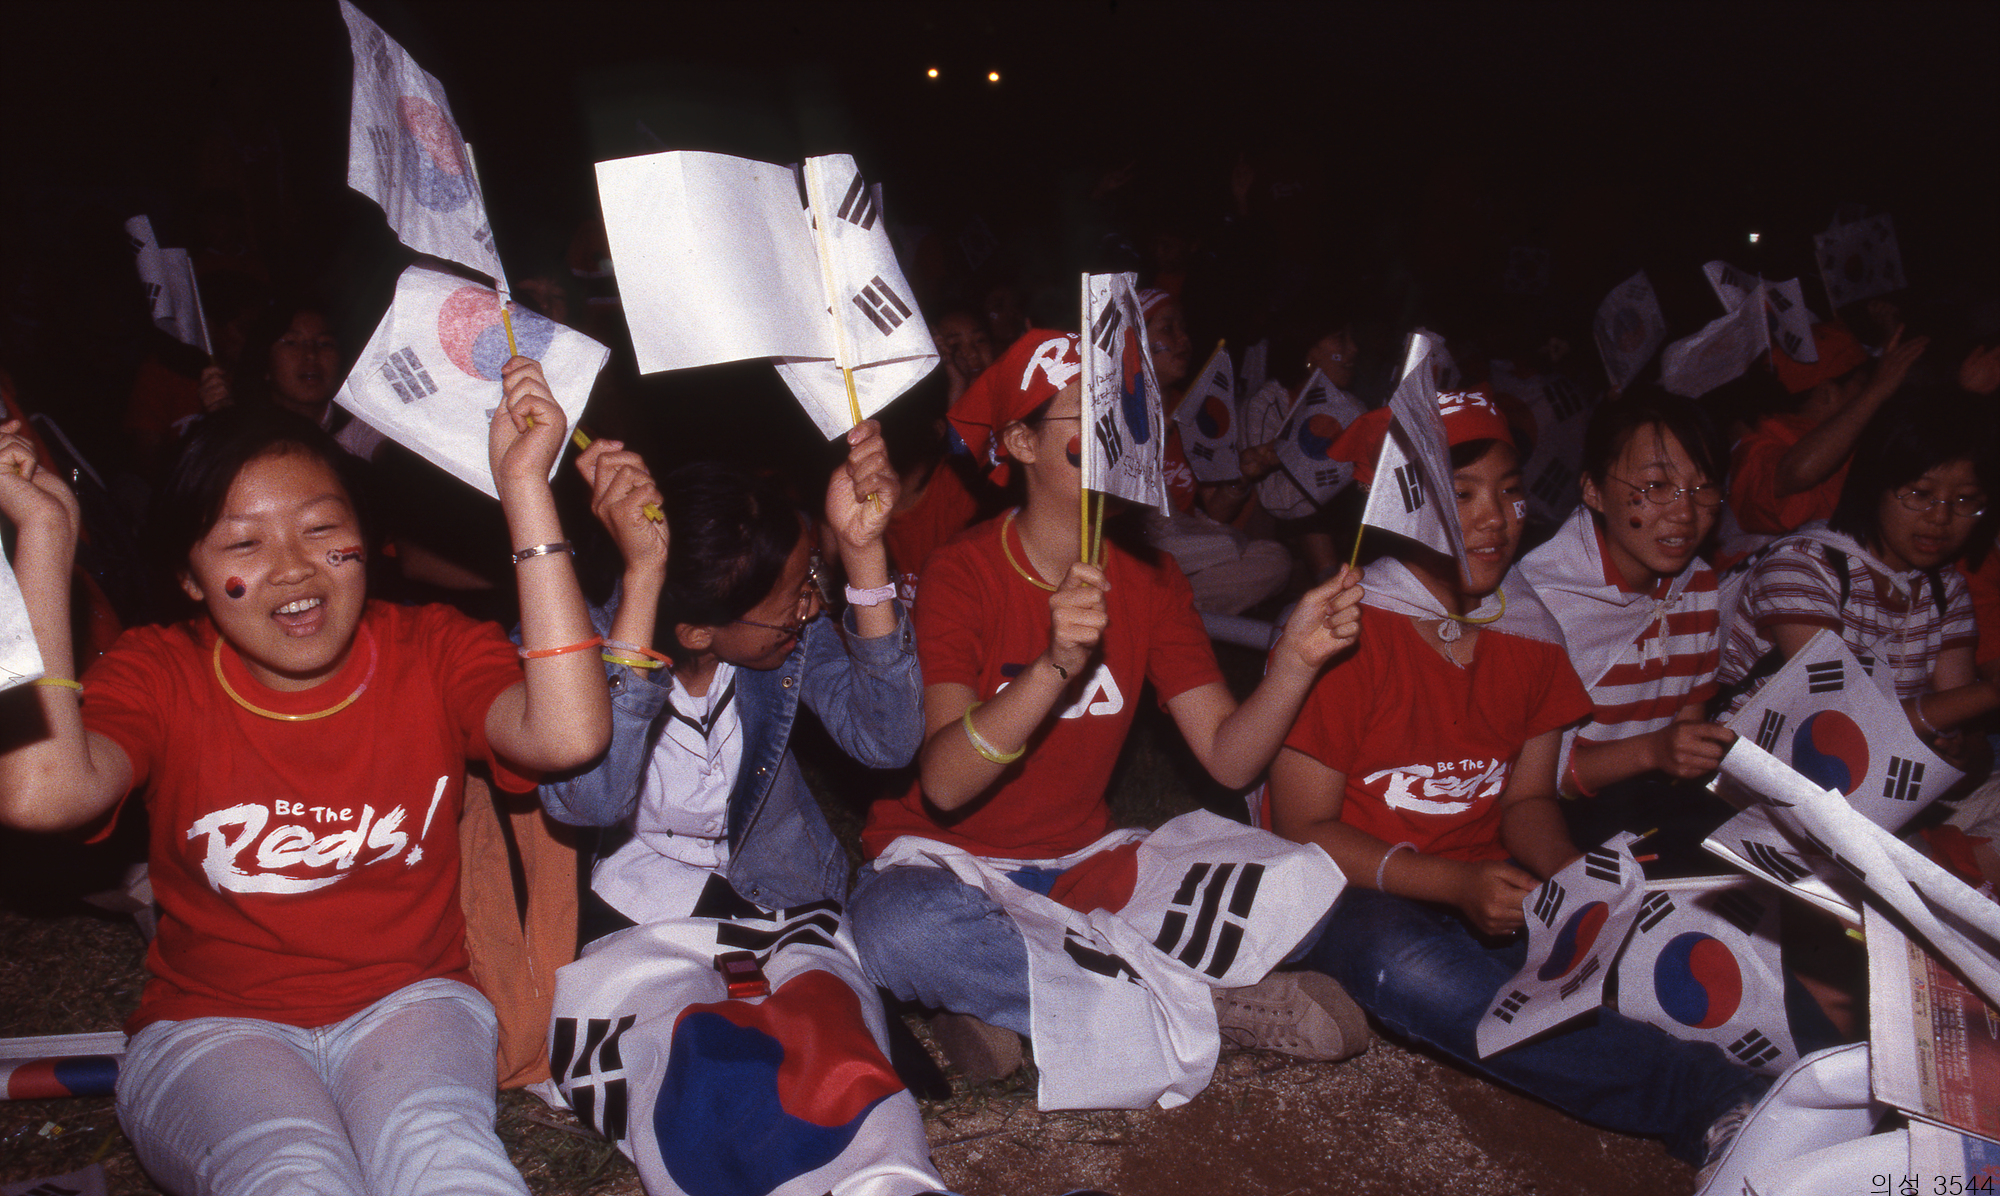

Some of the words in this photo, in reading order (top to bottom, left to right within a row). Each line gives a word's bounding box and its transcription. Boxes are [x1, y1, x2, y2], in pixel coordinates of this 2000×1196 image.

[1437, 761, 1454, 773] Be
[1459, 758, 1485, 771] The
[275, 799, 305, 817] Be
[309, 805, 354, 824] The
[186, 775, 449, 895] Reds!
